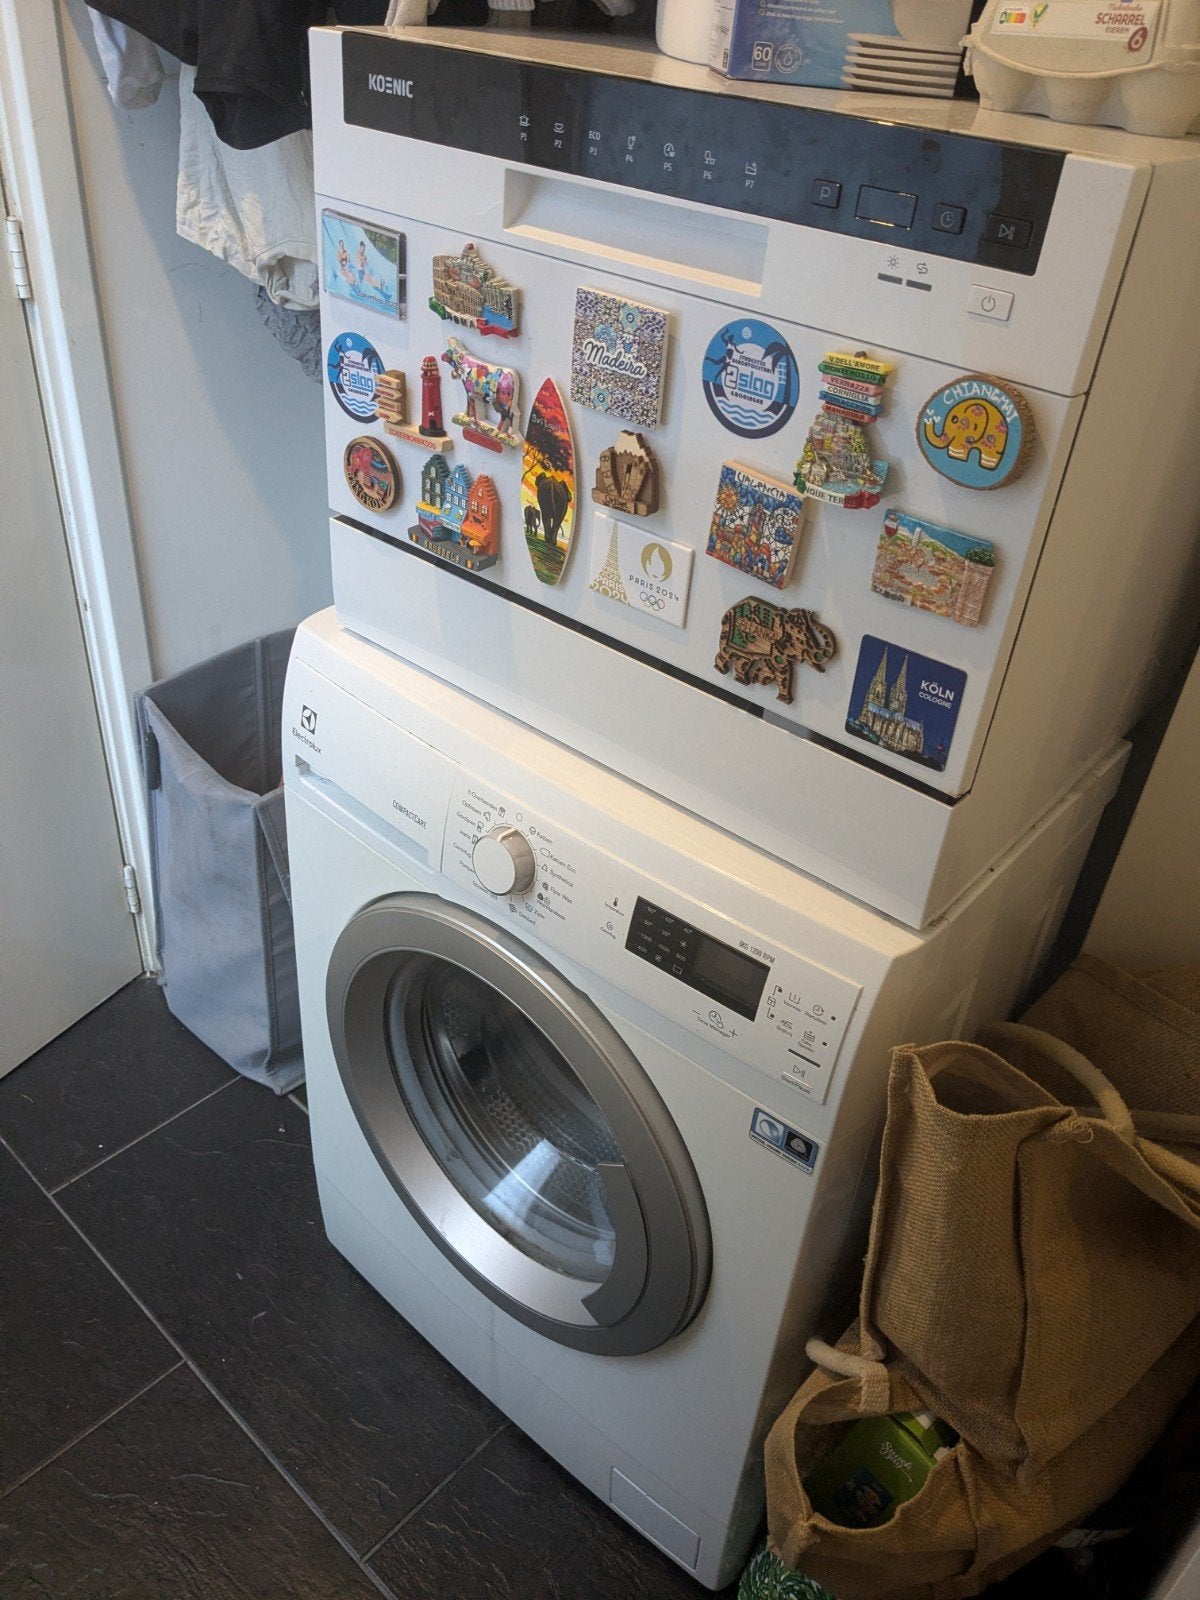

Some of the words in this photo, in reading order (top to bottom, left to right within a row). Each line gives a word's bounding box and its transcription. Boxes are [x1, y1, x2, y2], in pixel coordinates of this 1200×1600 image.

[1095, 12, 1146, 26] SCHARREL
[754, 46, 771, 60] 60
[368, 73, 414, 98] KOENIC
[520, 132, 528, 141] P1
[589, 130, 601, 140] ECO
[554, 140, 562, 148] P2
[589, 146, 598, 156] P3
[625, 154, 634, 164] P4
[663, 162, 672, 171] P5
[703, 170, 712, 180] P6
[746, 180, 754, 188] P7
[820, 187, 832, 202] P
[584, 341, 645, 376] Madeira
[825, 364, 879, 381] MONTEROSSO
[830, 376, 870, 394] VERNAZZA
[730, 390, 764, 405] GRONINGEN
[828, 386, 870, 402] CORNIGLIA
[943, 382, 1019, 423] CHIANGMAI
[388, 428, 437, 450] SCHIERMONNIKOOG
[347, 469, 388, 509] BANGKOK
[737, 472, 786, 500] VALENCIA
[423, 540, 461, 563] BRUSSELS
[629, 574, 654, 591] PARIS
[655, 586, 680, 602] 2024
[920, 680, 954, 701] KÖLN
[918, 691, 952, 709] COLOGNE
[292, 726, 322, 755] Electrolux
[392, 799, 427, 830] COMPACTCARE
[641, 932, 653, 943] 1200
[762, 952, 776, 964] RPM
